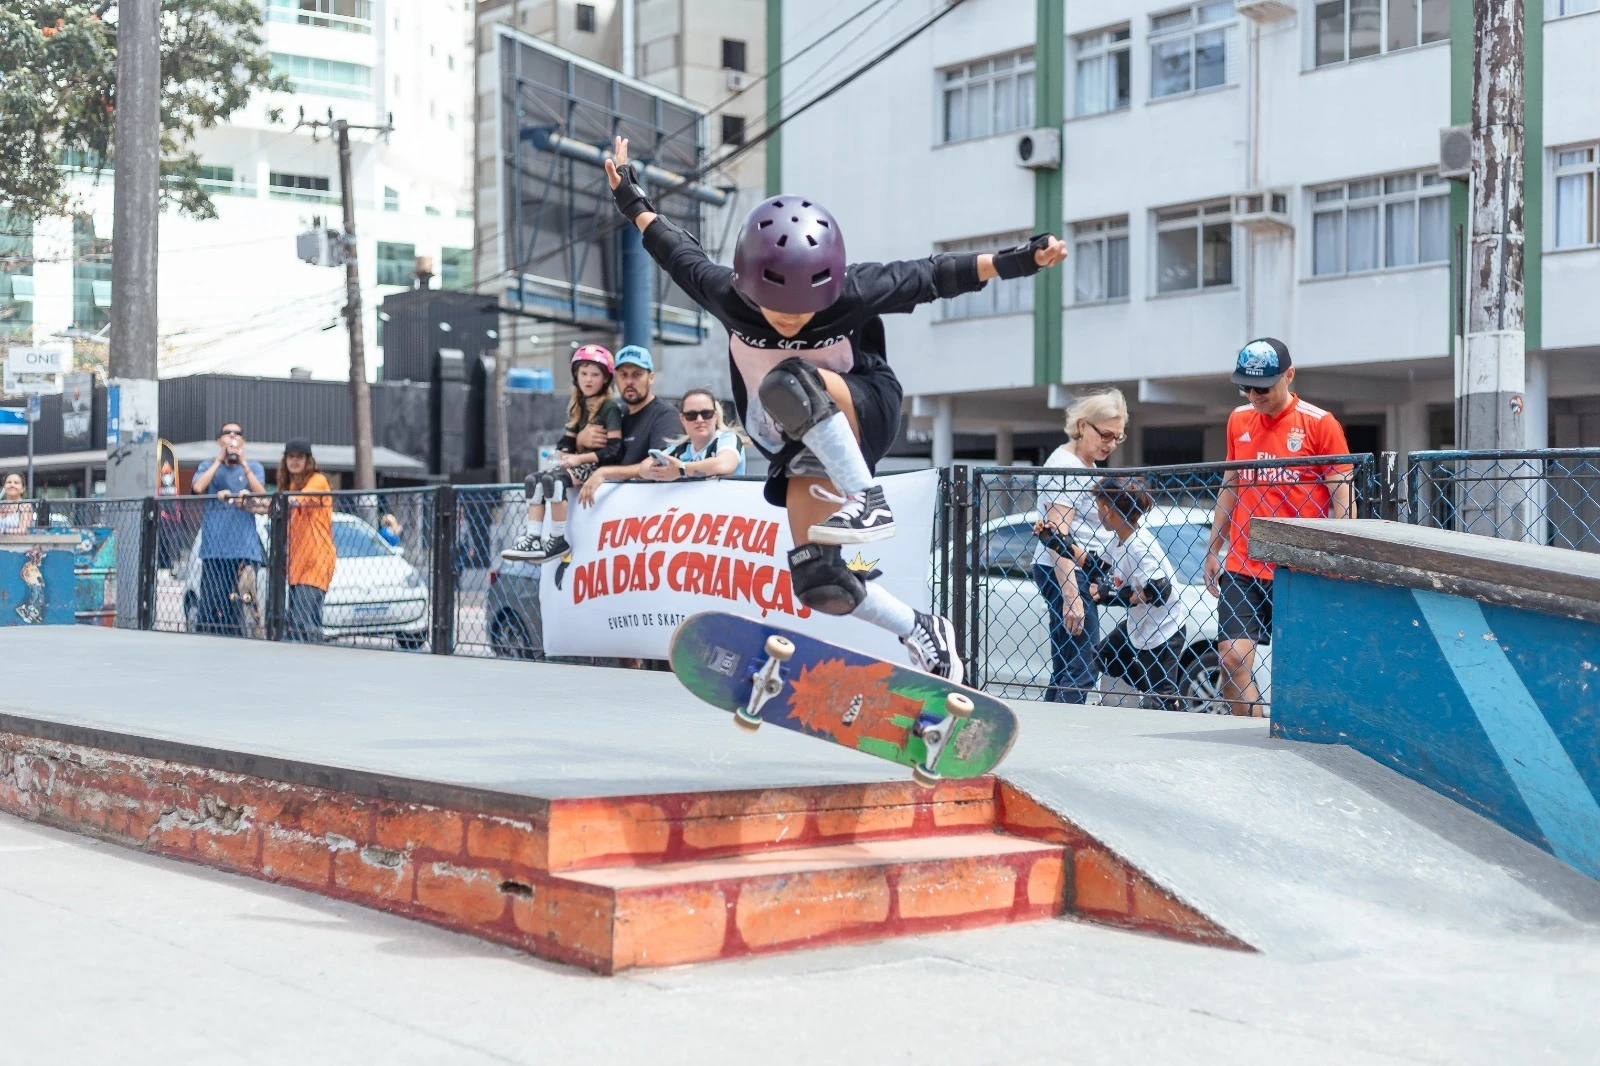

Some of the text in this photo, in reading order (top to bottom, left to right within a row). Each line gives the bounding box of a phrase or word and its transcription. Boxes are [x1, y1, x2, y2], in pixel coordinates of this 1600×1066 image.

[26, 353, 60, 365] ONE
[597, 507, 780, 557] FUNÇÃO DE RUA
[573, 561, 609, 605] DIA
[612, 550, 666, 595] DAS
[608, 614, 639, 630] EVENTO
[642, 613, 654, 626] DE
